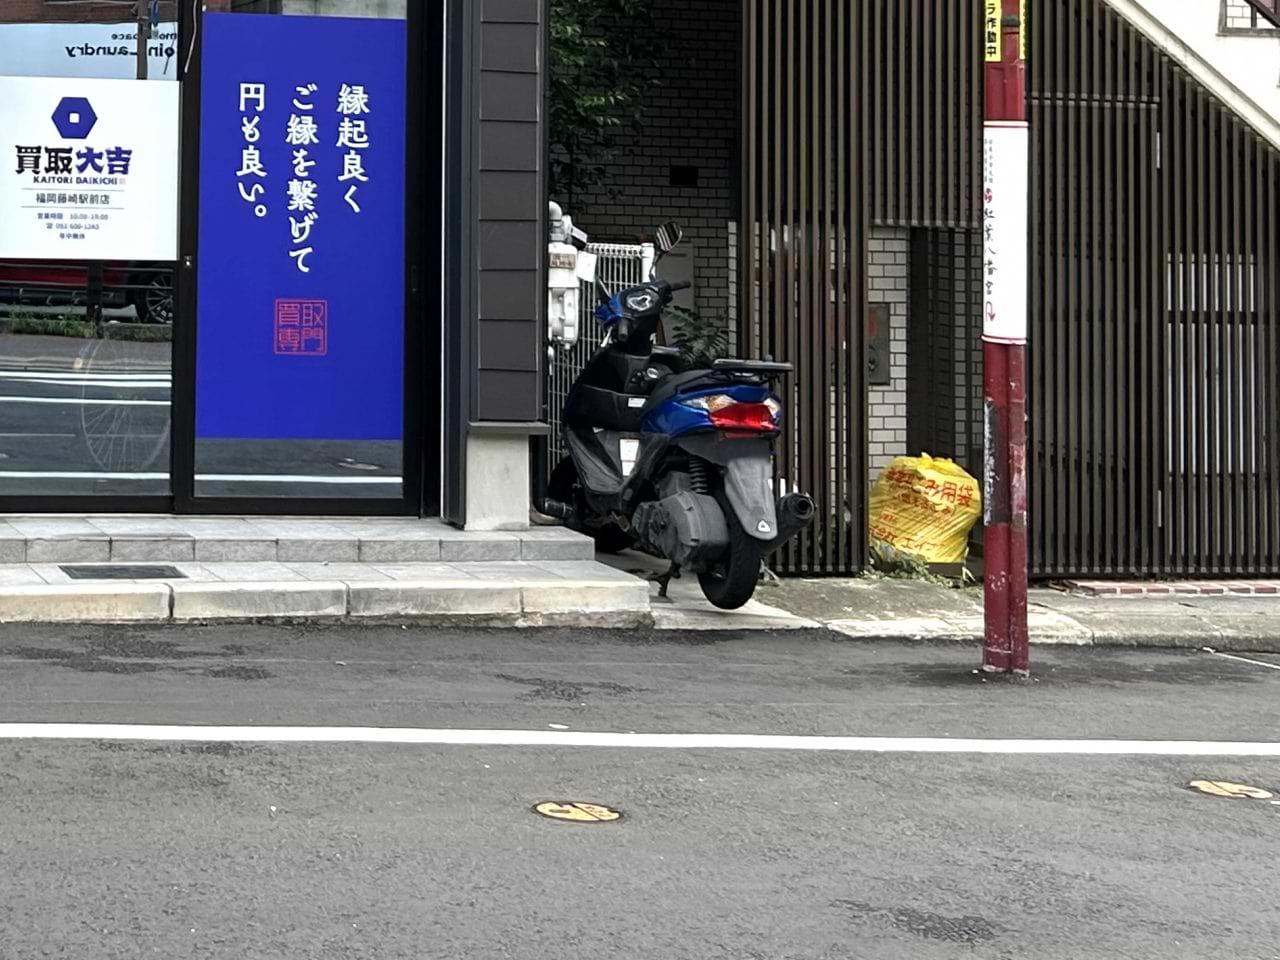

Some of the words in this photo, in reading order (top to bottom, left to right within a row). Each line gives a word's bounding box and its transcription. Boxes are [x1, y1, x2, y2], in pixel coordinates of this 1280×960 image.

[14, 144, 133, 176] 買取大吉
[33, 175, 73, 184] KAITORI
[75, 176, 118, 185] DAIKICHI
[236, 82, 268, 218] 円も良い。
[285, 83, 320, 273] ご縁を繋げて
[336, 83, 370, 214] 縁起良く
[35, 193, 110, 205] 福岡藤崎駅前店
